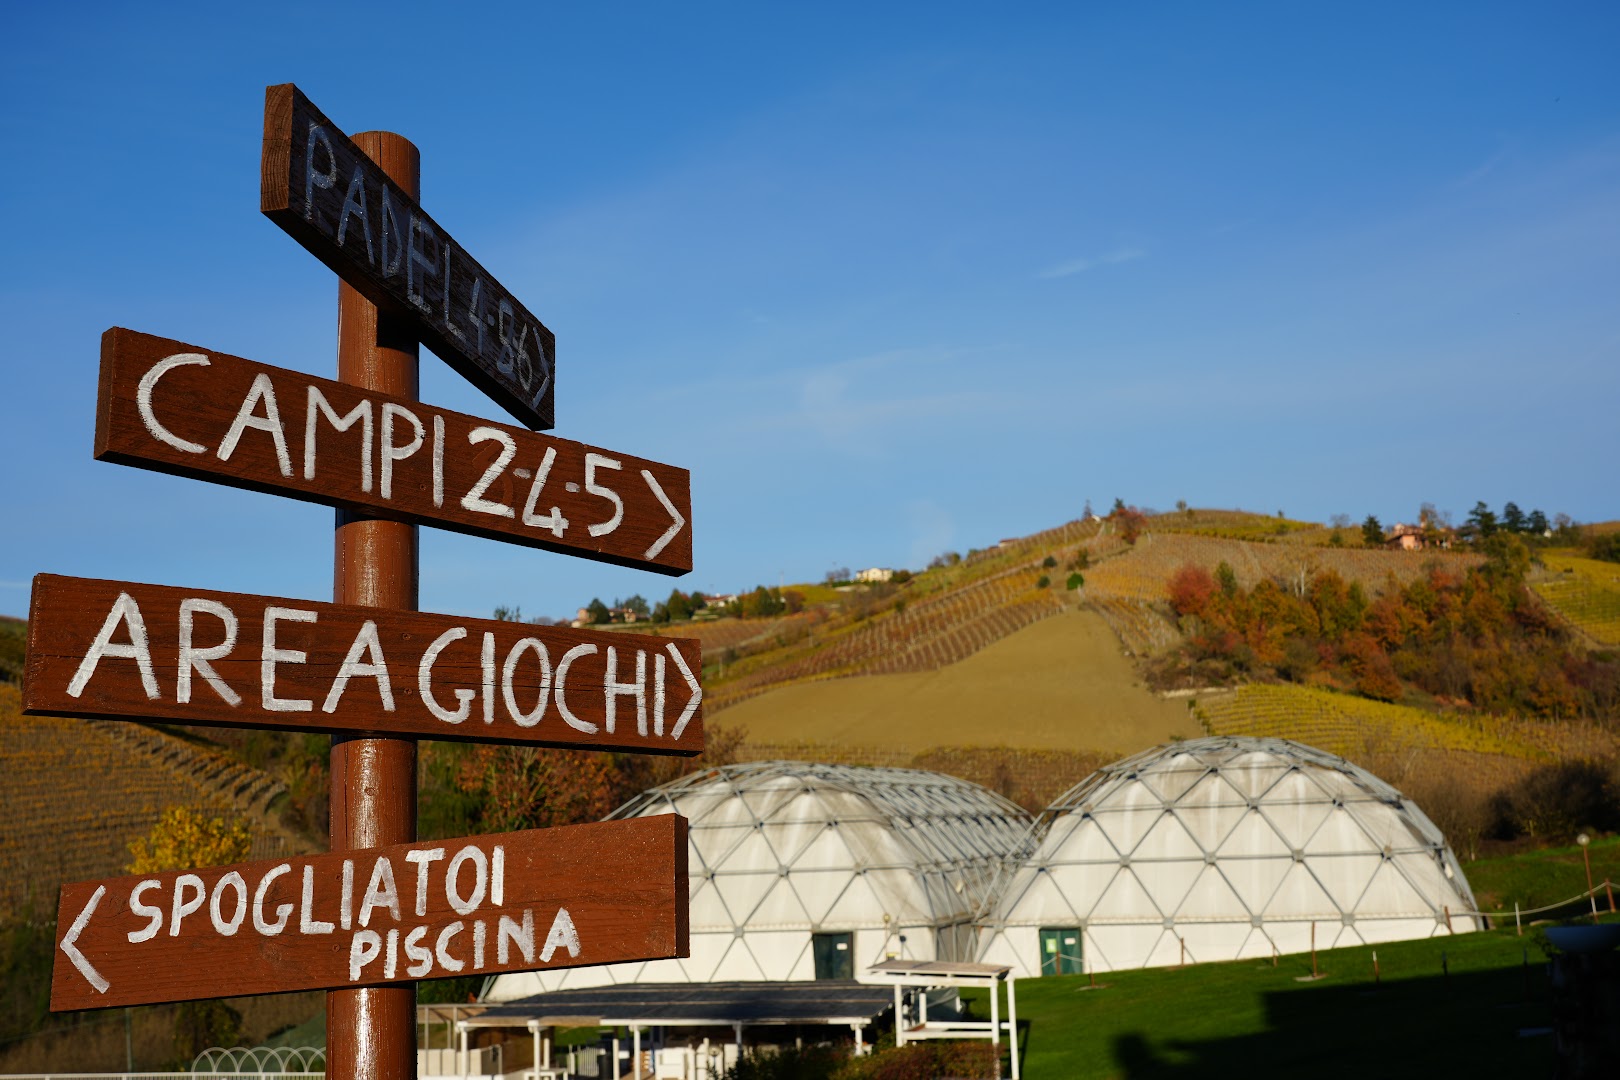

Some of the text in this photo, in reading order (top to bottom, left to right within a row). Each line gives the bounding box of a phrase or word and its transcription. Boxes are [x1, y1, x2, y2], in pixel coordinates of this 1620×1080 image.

[303, 120, 466, 344] PADEL
[137, 353, 624, 538] CAMPI 2-4-5
[66, 591, 666, 738] AREA GIOCHI
[128, 845, 504, 942] SPOGLIATOI
[349, 907, 582, 981] PISCINA
